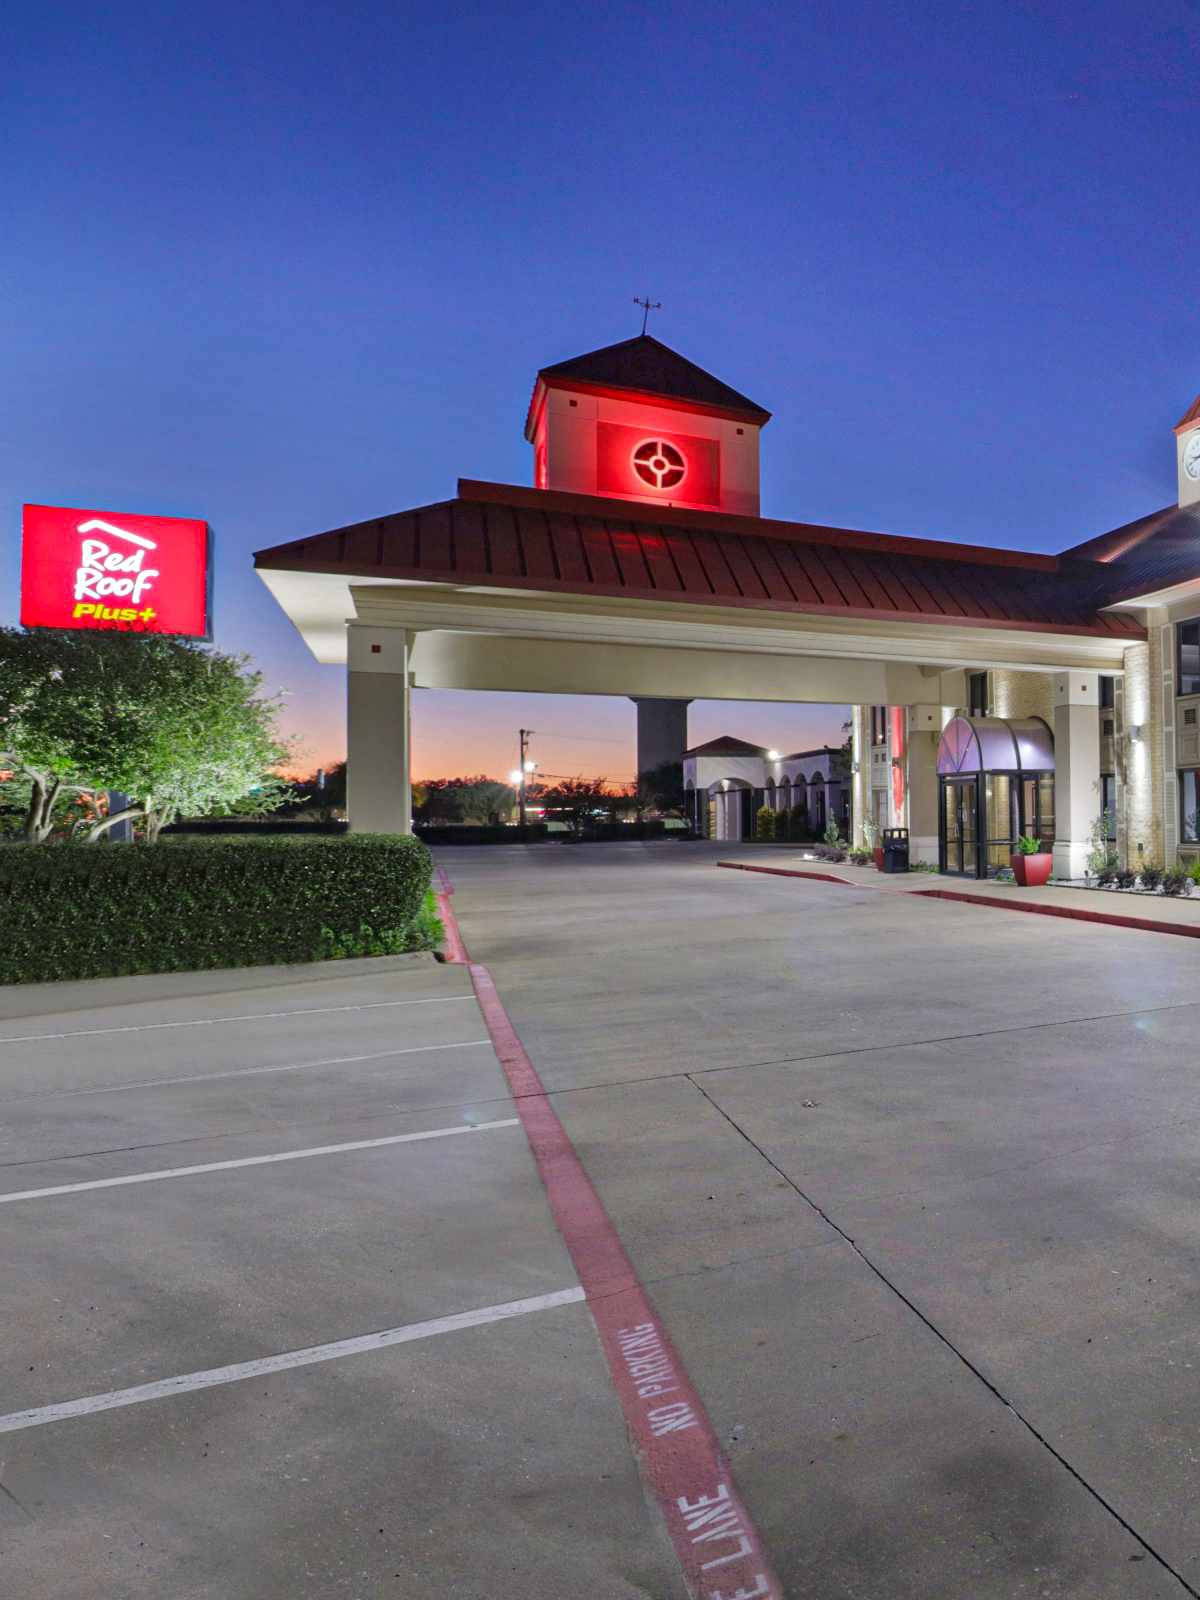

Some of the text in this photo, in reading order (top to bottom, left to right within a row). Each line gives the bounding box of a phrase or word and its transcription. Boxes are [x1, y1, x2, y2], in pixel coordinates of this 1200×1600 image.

[82, 539, 145, 572] Red
[74, 567, 159, 604] Roof
[72, 603, 156, 621] Plus+
[617, 1323, 680, 1399] PARKING
[647, 1402, 698, 1436] NO
[677, 1484, 752, 1570] LANE
